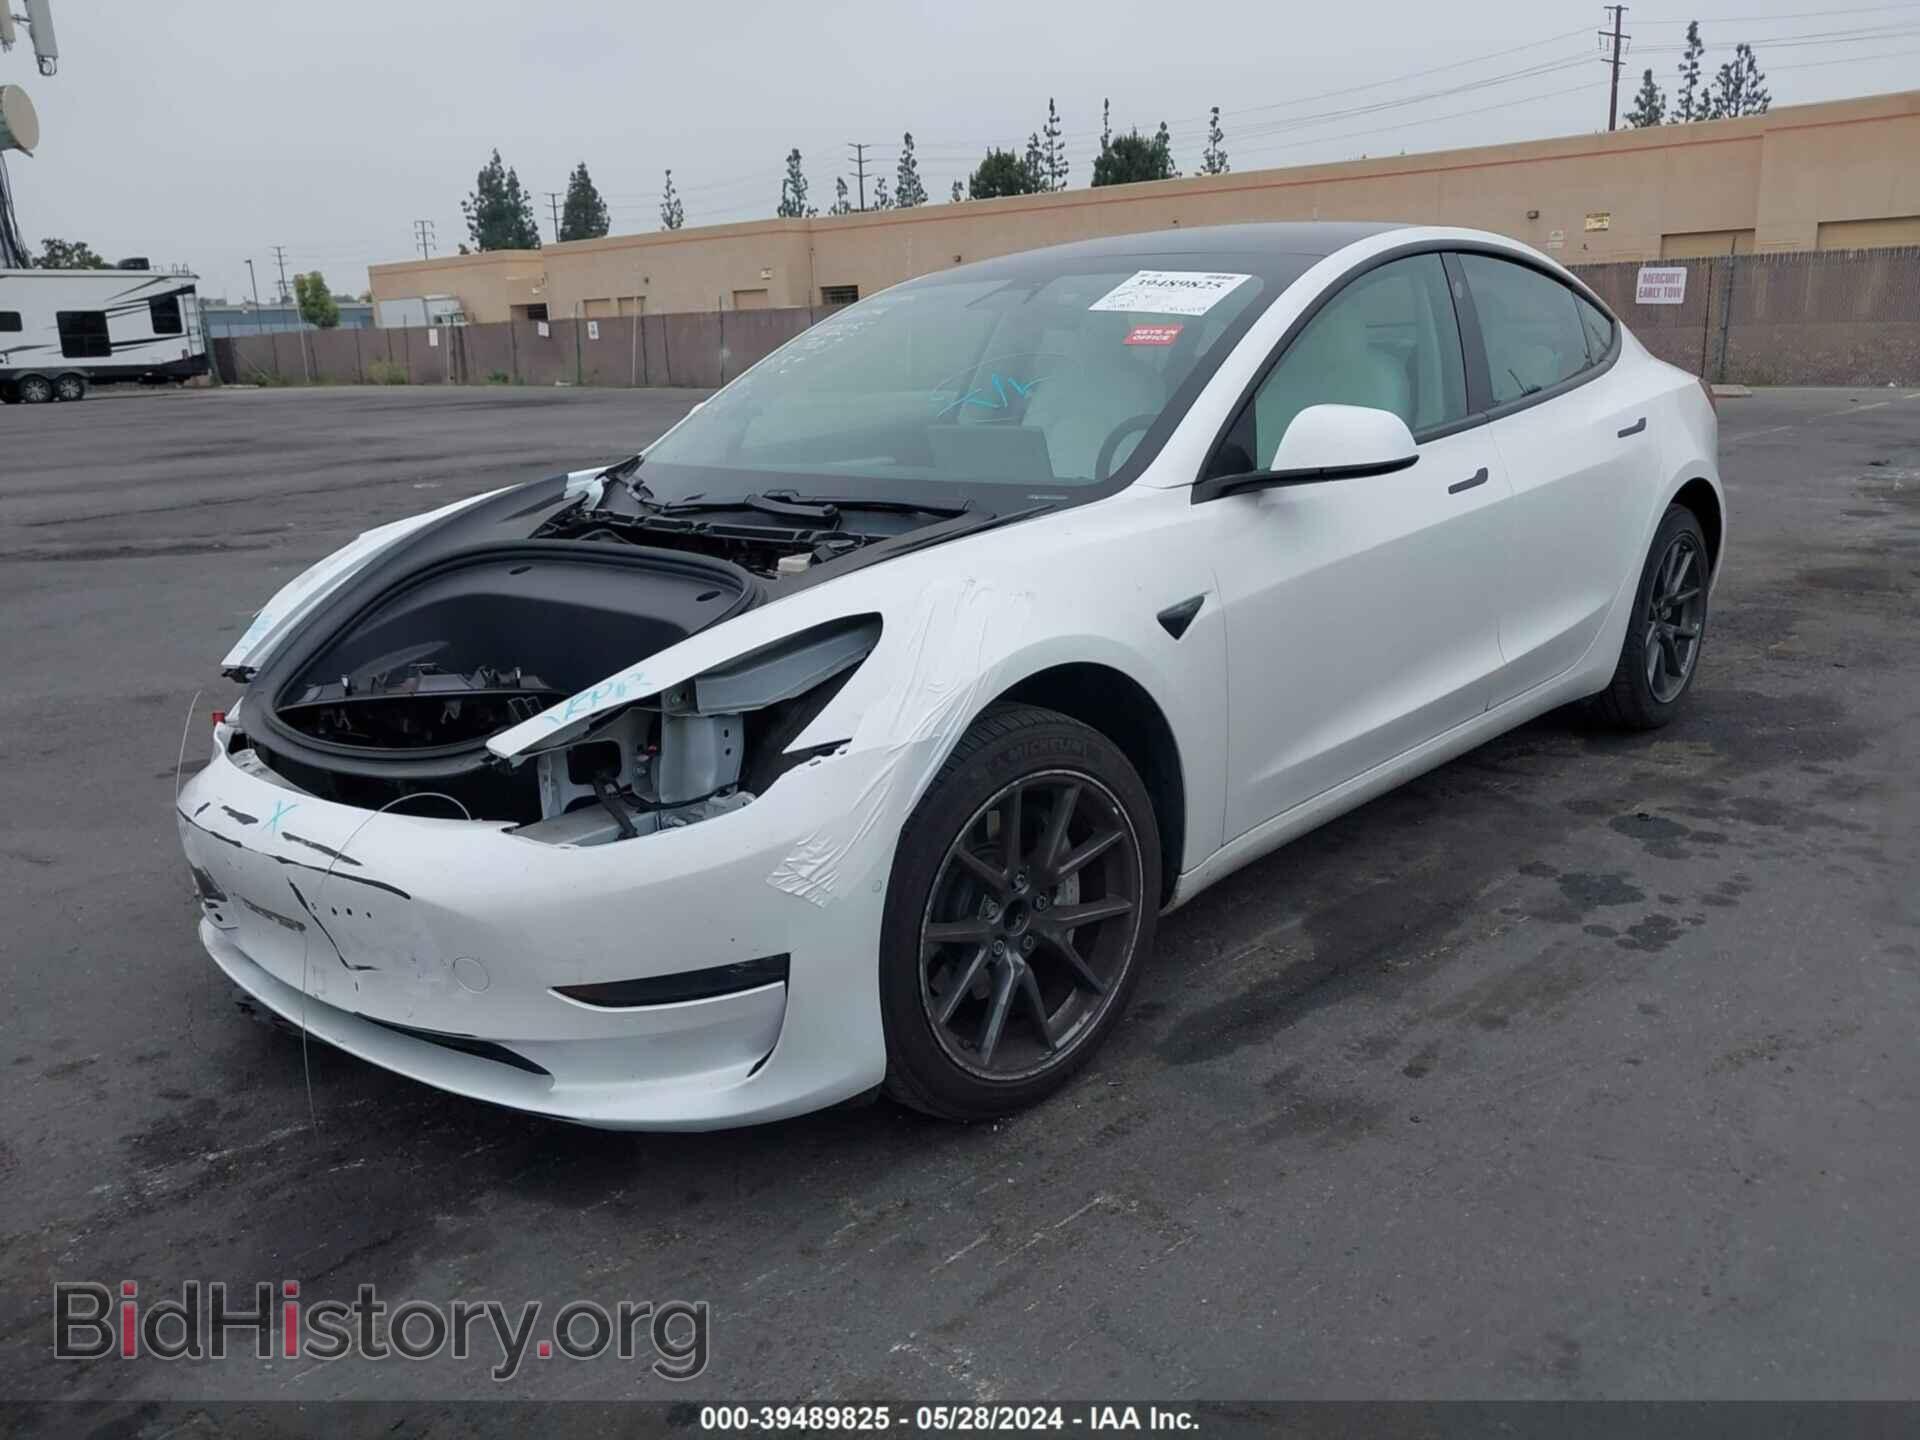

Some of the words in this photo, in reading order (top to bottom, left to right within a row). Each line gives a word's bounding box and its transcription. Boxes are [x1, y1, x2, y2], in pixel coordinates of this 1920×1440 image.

[1642, 273, 1682, 284] MERCURY
[1639, 287, 1661, 298] EARLY
[1663, 287, 1682, 298] TOW
